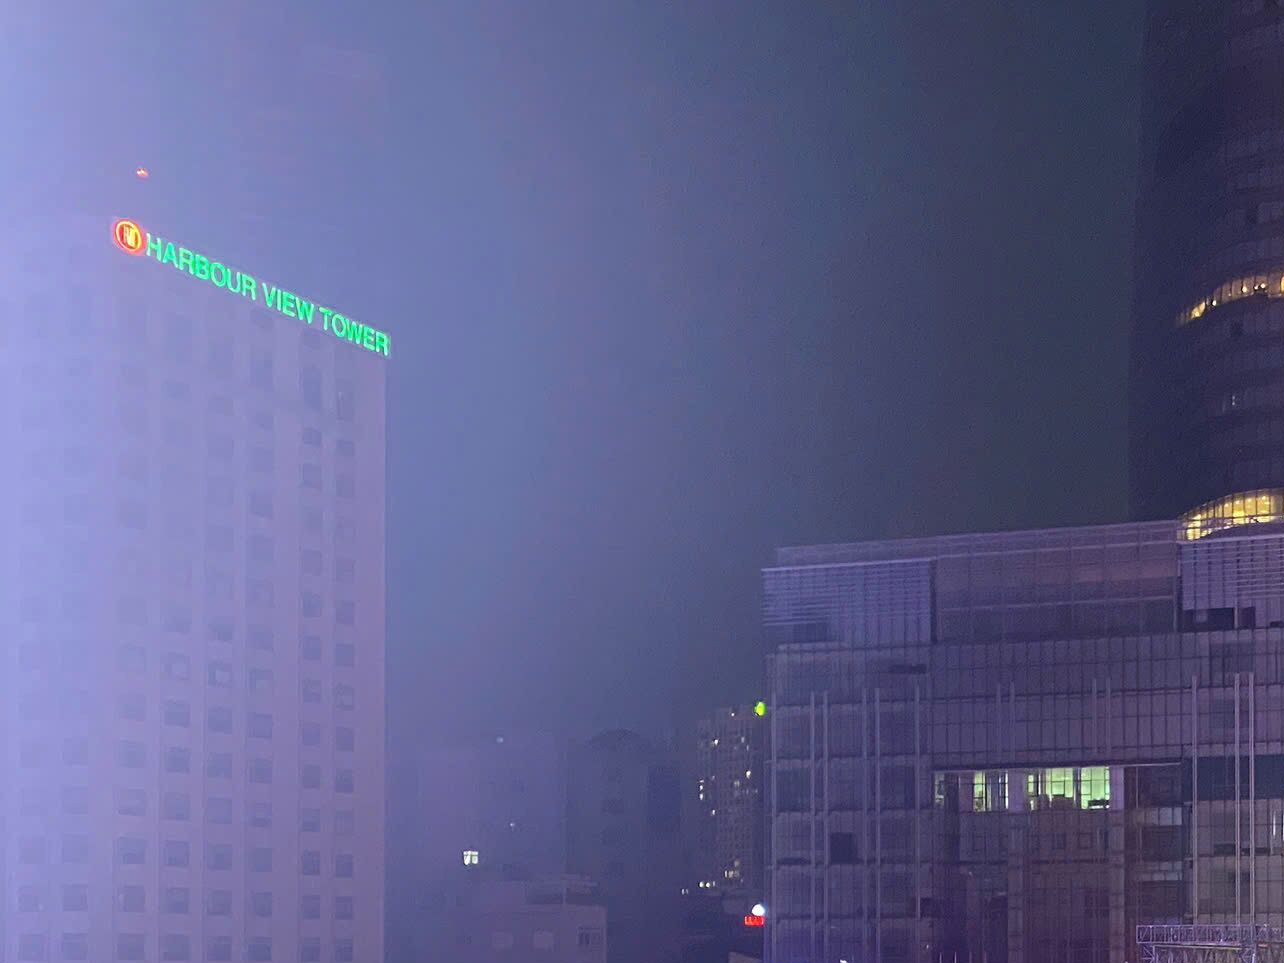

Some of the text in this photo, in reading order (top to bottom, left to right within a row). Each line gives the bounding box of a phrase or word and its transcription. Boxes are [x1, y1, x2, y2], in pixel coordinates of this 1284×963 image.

[146, 232, 390, 357] HARBOUR VIEW TOWER
